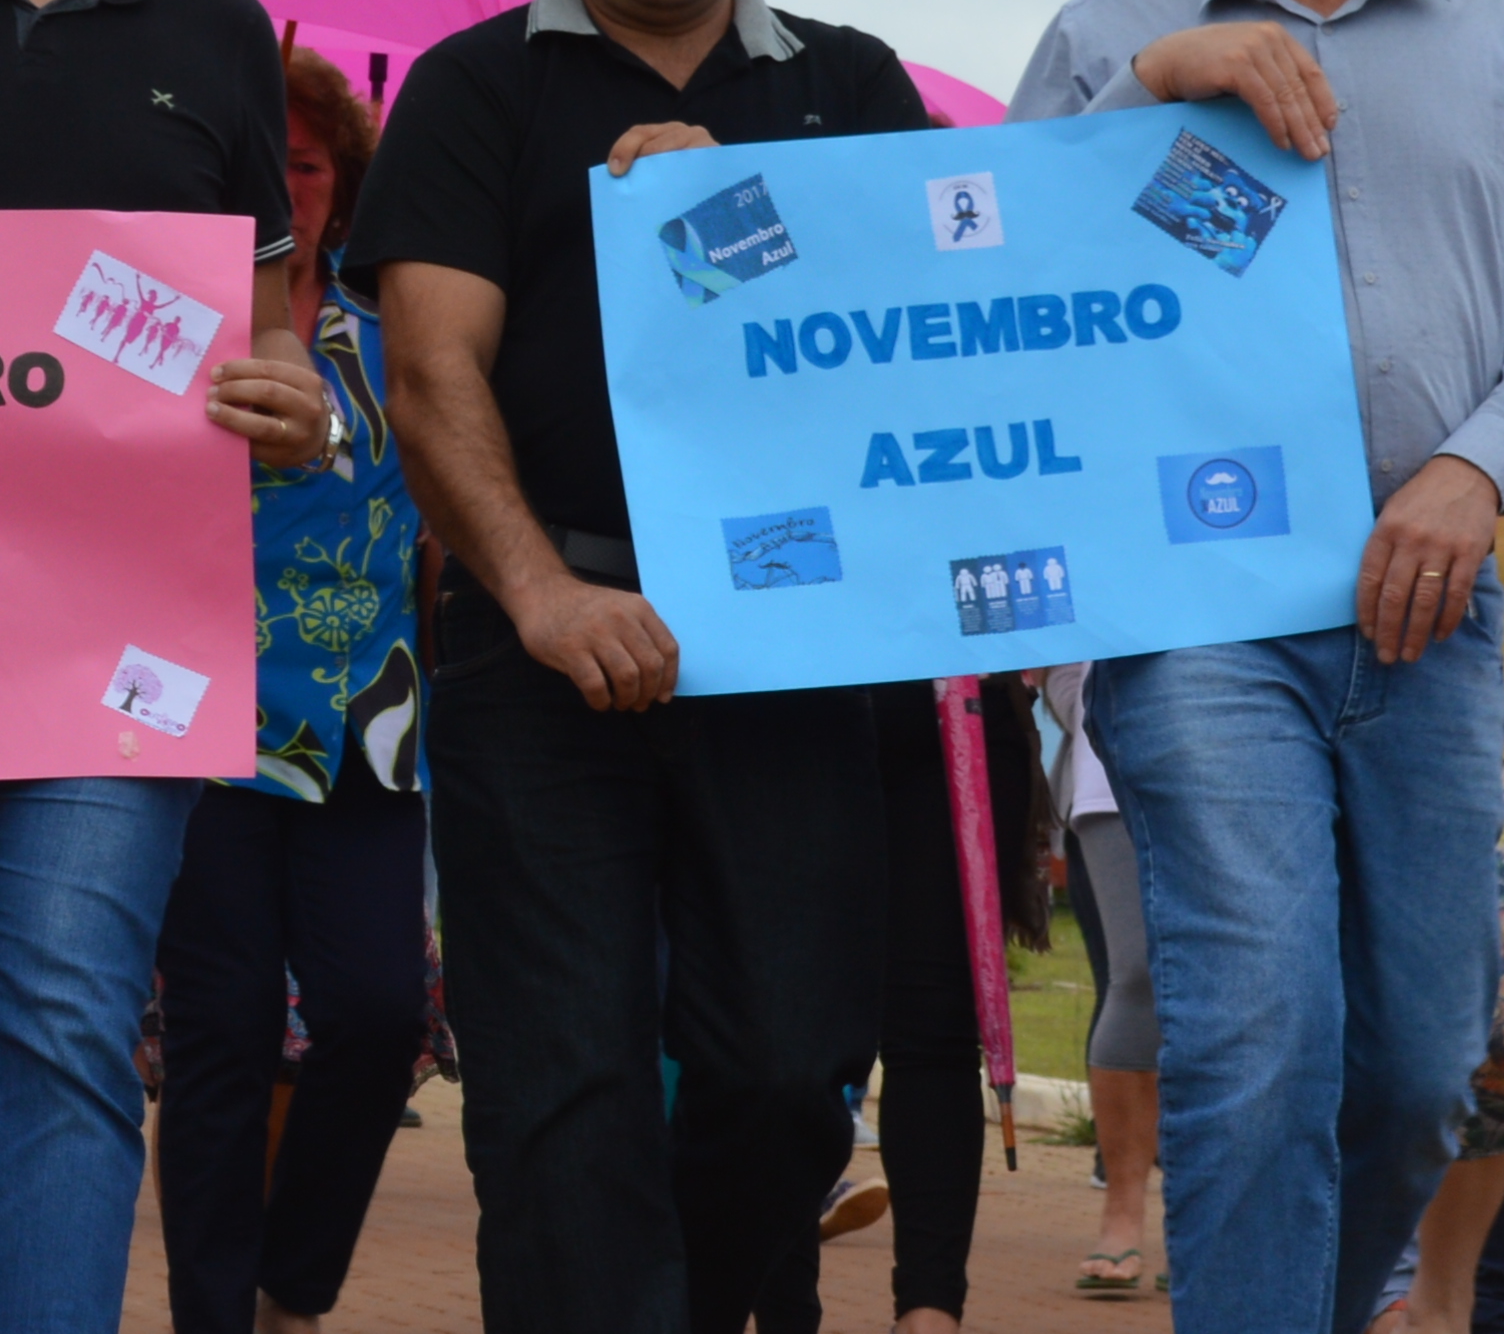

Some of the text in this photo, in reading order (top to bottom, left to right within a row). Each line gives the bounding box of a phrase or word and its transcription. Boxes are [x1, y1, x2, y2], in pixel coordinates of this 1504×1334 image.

[734, 180, 769, 208] 2017
[708, 222, 785, 264] Novembro
[761, 241, 794, 266] Azul
[742, 283, 1182, 378] NOVEMBRO
[858, 418, 1083, 489] AZUL
[1208, 497, 1241, 513] AZUL
